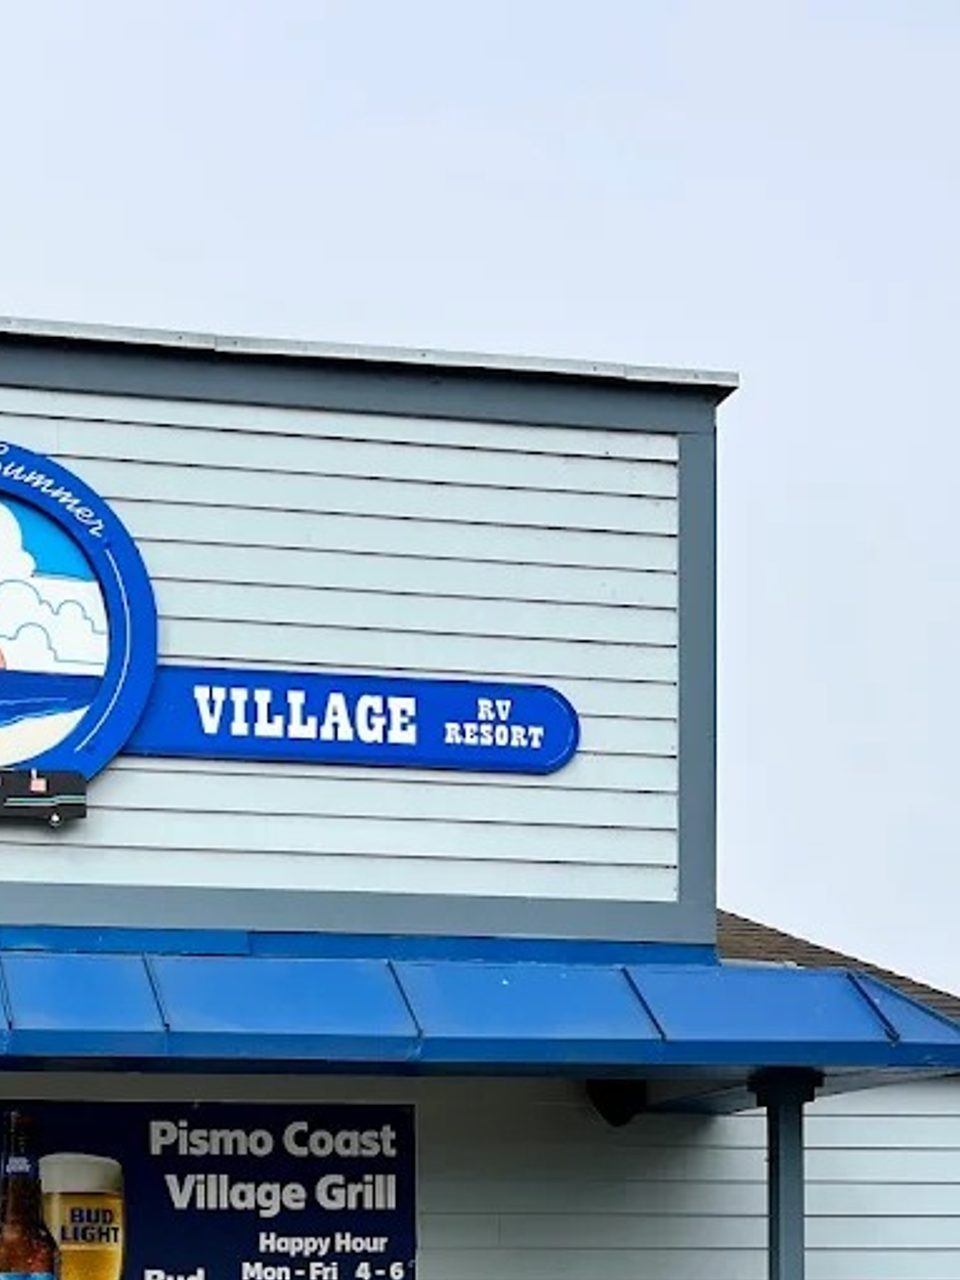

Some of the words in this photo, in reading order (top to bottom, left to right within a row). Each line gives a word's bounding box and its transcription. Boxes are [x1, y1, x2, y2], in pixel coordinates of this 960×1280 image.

[193, 685, 416, 744] VILLAGE
[478, 699, 512, 721] RV
[444, 722, 544, 748] RESORT
[150, 1121, 273, 1156] Pismo
[284, 1122, 397, 1156] Coast
[165, 1174, 306, 1218] Village
[316, 1174, 397, 1210] Grill
[70, 1206, 113, 1226] BUD
[60, 1226, 120, 1243] LIGHT
[259, 1232, 331, 1257] Happy
[334, 1232, 388, 1253] Hour
[241, 1262, 291, 1280] Mon
[309, 1261, 338, 1280] Fri
[355, 1261, 372, 1280] 4
[389, 1261, 404, 1280] 6
